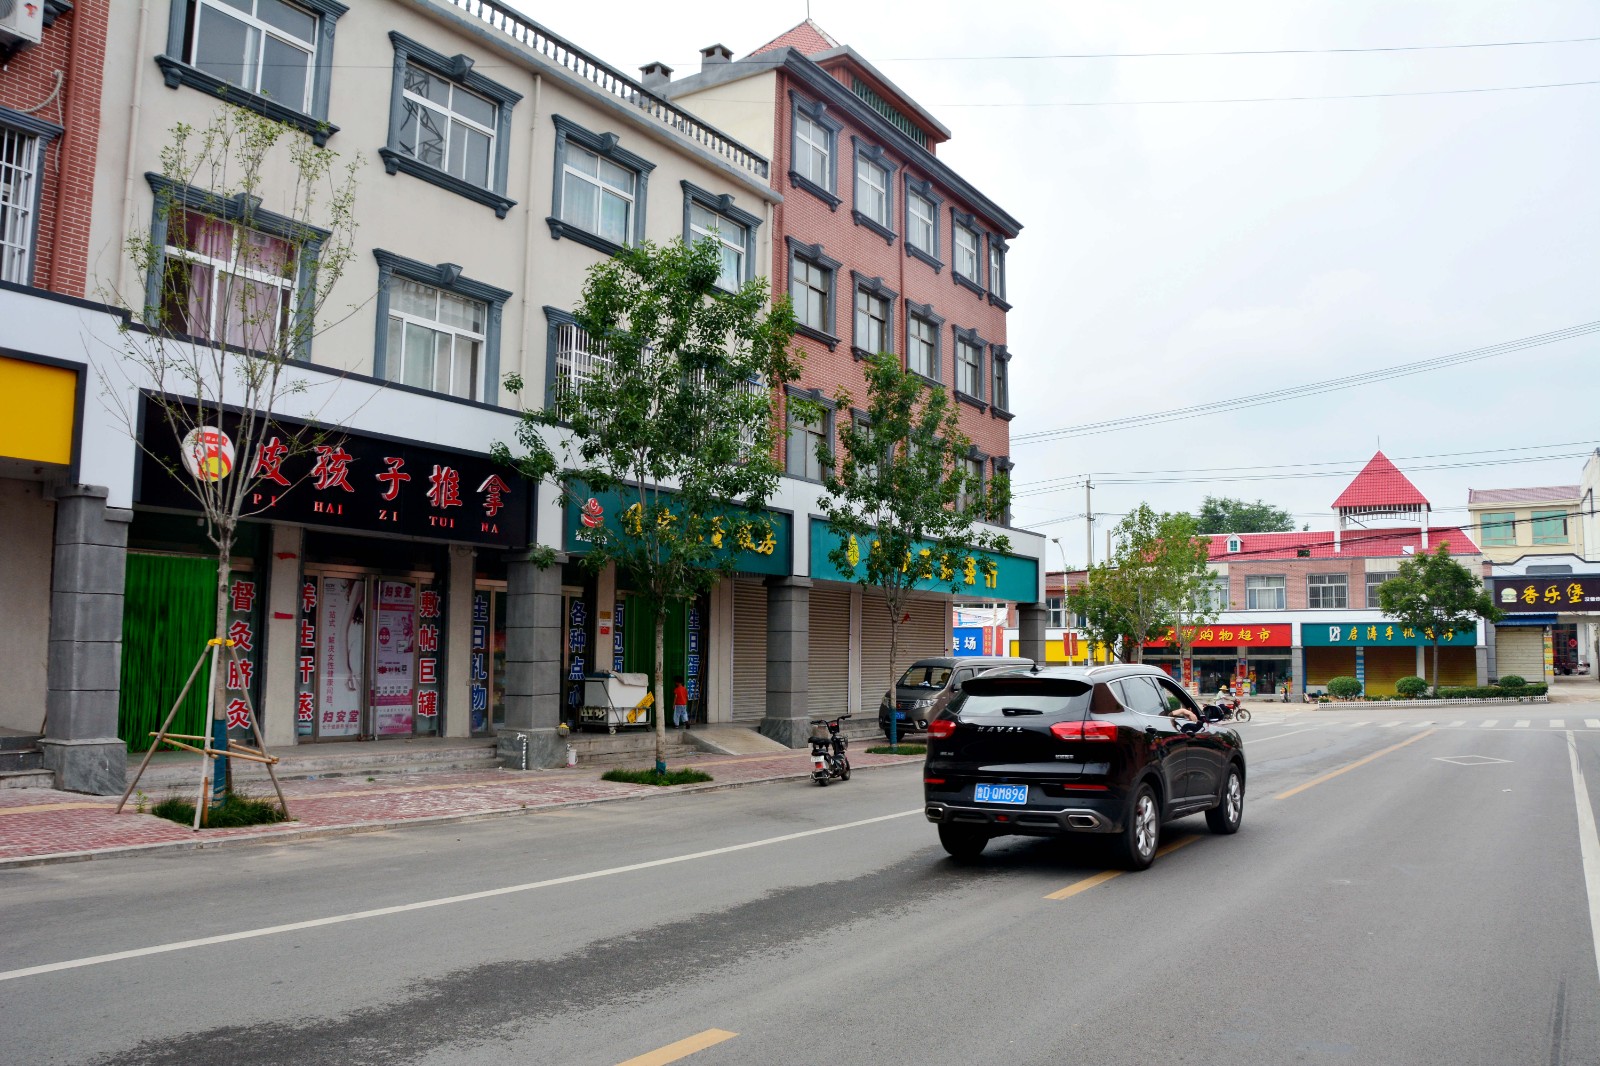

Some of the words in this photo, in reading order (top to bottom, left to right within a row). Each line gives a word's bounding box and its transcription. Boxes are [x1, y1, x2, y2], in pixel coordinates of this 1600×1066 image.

[251, 436, 512, 517] 皮孩子推拿
[253, 493, 278, 507] PI
[314, 501, 343, 515] HAI
[379, 509, 398, 522] ZI
[429, 516, 455, 528] TUI
[481, 523, 499, 534] NA
[385, 585, 412, 599] 妇安堂
[1521, 583, 1584, 604] 香乐堡
[226, 580, 256, 731] 督灸脐灸
[298, 583, 317, 722] 养生干蒸
[471, 595, 488, 711] 生日礼物
[568, 600, 587, 709] 各种点心
[687, 608, 701, 701] 生日蛋糕
[323, 710, 360, 723] 妇安堂
